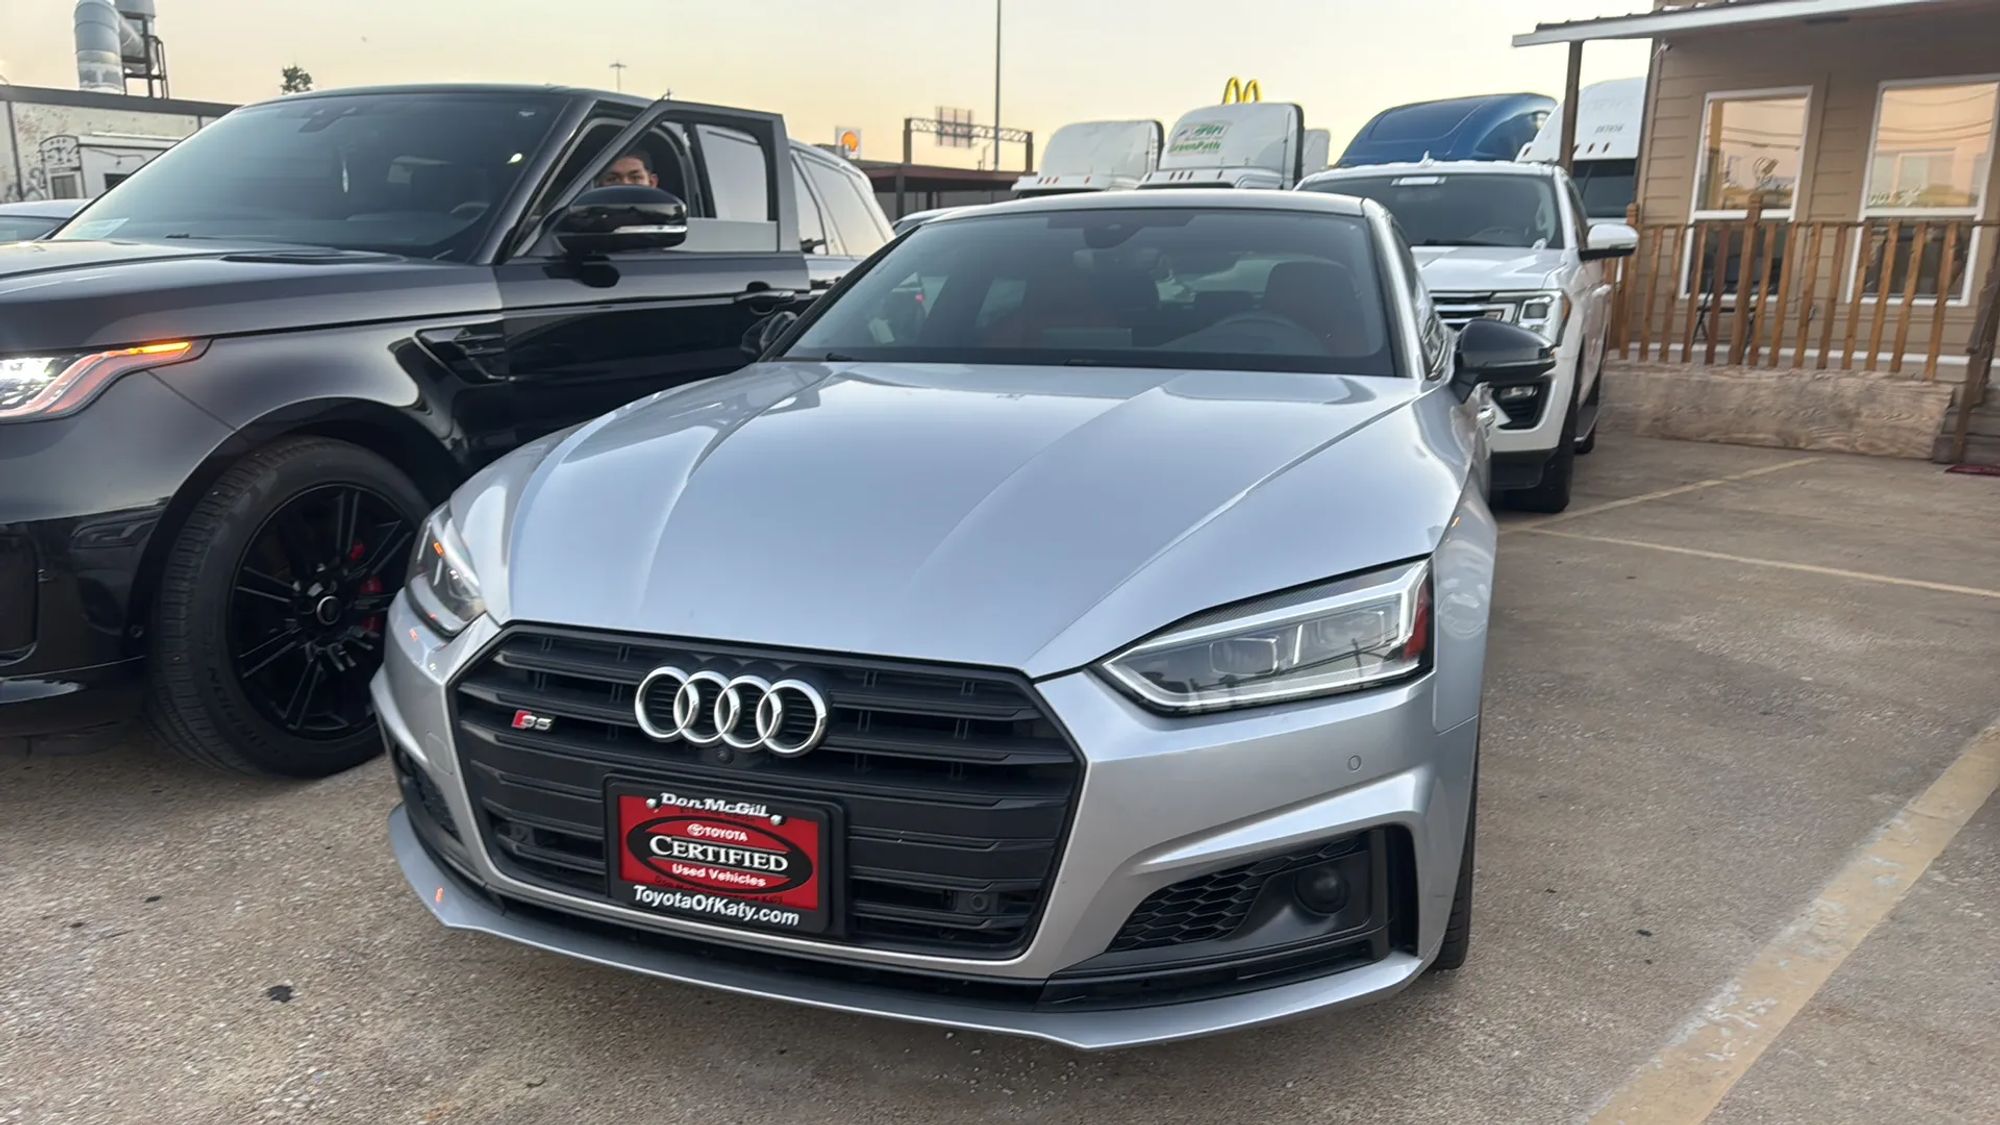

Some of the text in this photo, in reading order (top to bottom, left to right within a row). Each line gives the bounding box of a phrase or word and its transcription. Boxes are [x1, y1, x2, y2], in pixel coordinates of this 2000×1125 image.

[660, 792, 704, 809] Don
[703, 798, 770, 817] McGill
[703, 826, 748, 842] TOYOTA
[650, 834, 789, 872] CERTIFIED
[672, 863, 767, 888] Used Vehicles
[633, 884, 800, 926] ToyotaOfKaty.com
